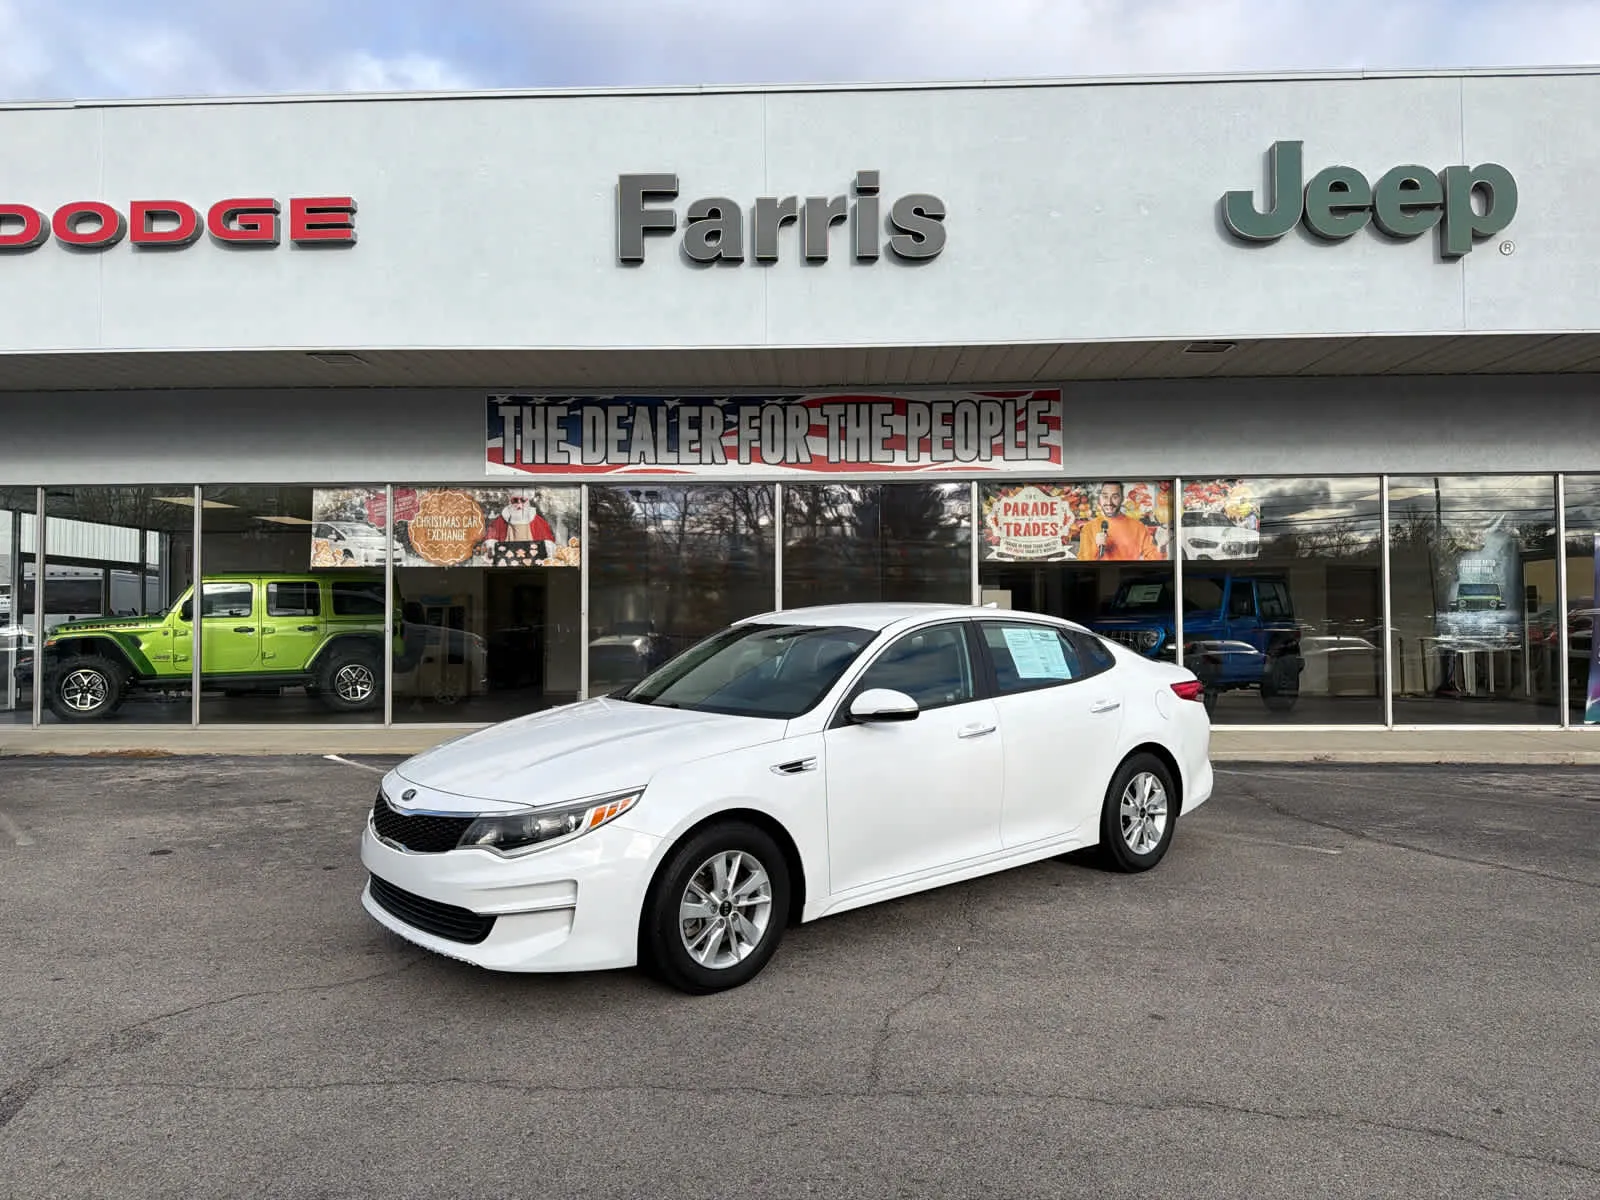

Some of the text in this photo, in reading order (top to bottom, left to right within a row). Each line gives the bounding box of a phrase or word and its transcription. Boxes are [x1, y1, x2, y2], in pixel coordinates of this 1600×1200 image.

[1220, 140, 1518, 258] Jeep
[616, 170, 947, 263] Farris
[498, 399, 1051, 465] THE DEALER FOR THE PEOPLE
[1003, 502, 1058, 516] PARADE
[416, 515, 478, 528] CHRISTMAS CAR
[427, 528, 466, 541] EXCHANGE
[1003, 522, 1059, 537] TRADES
